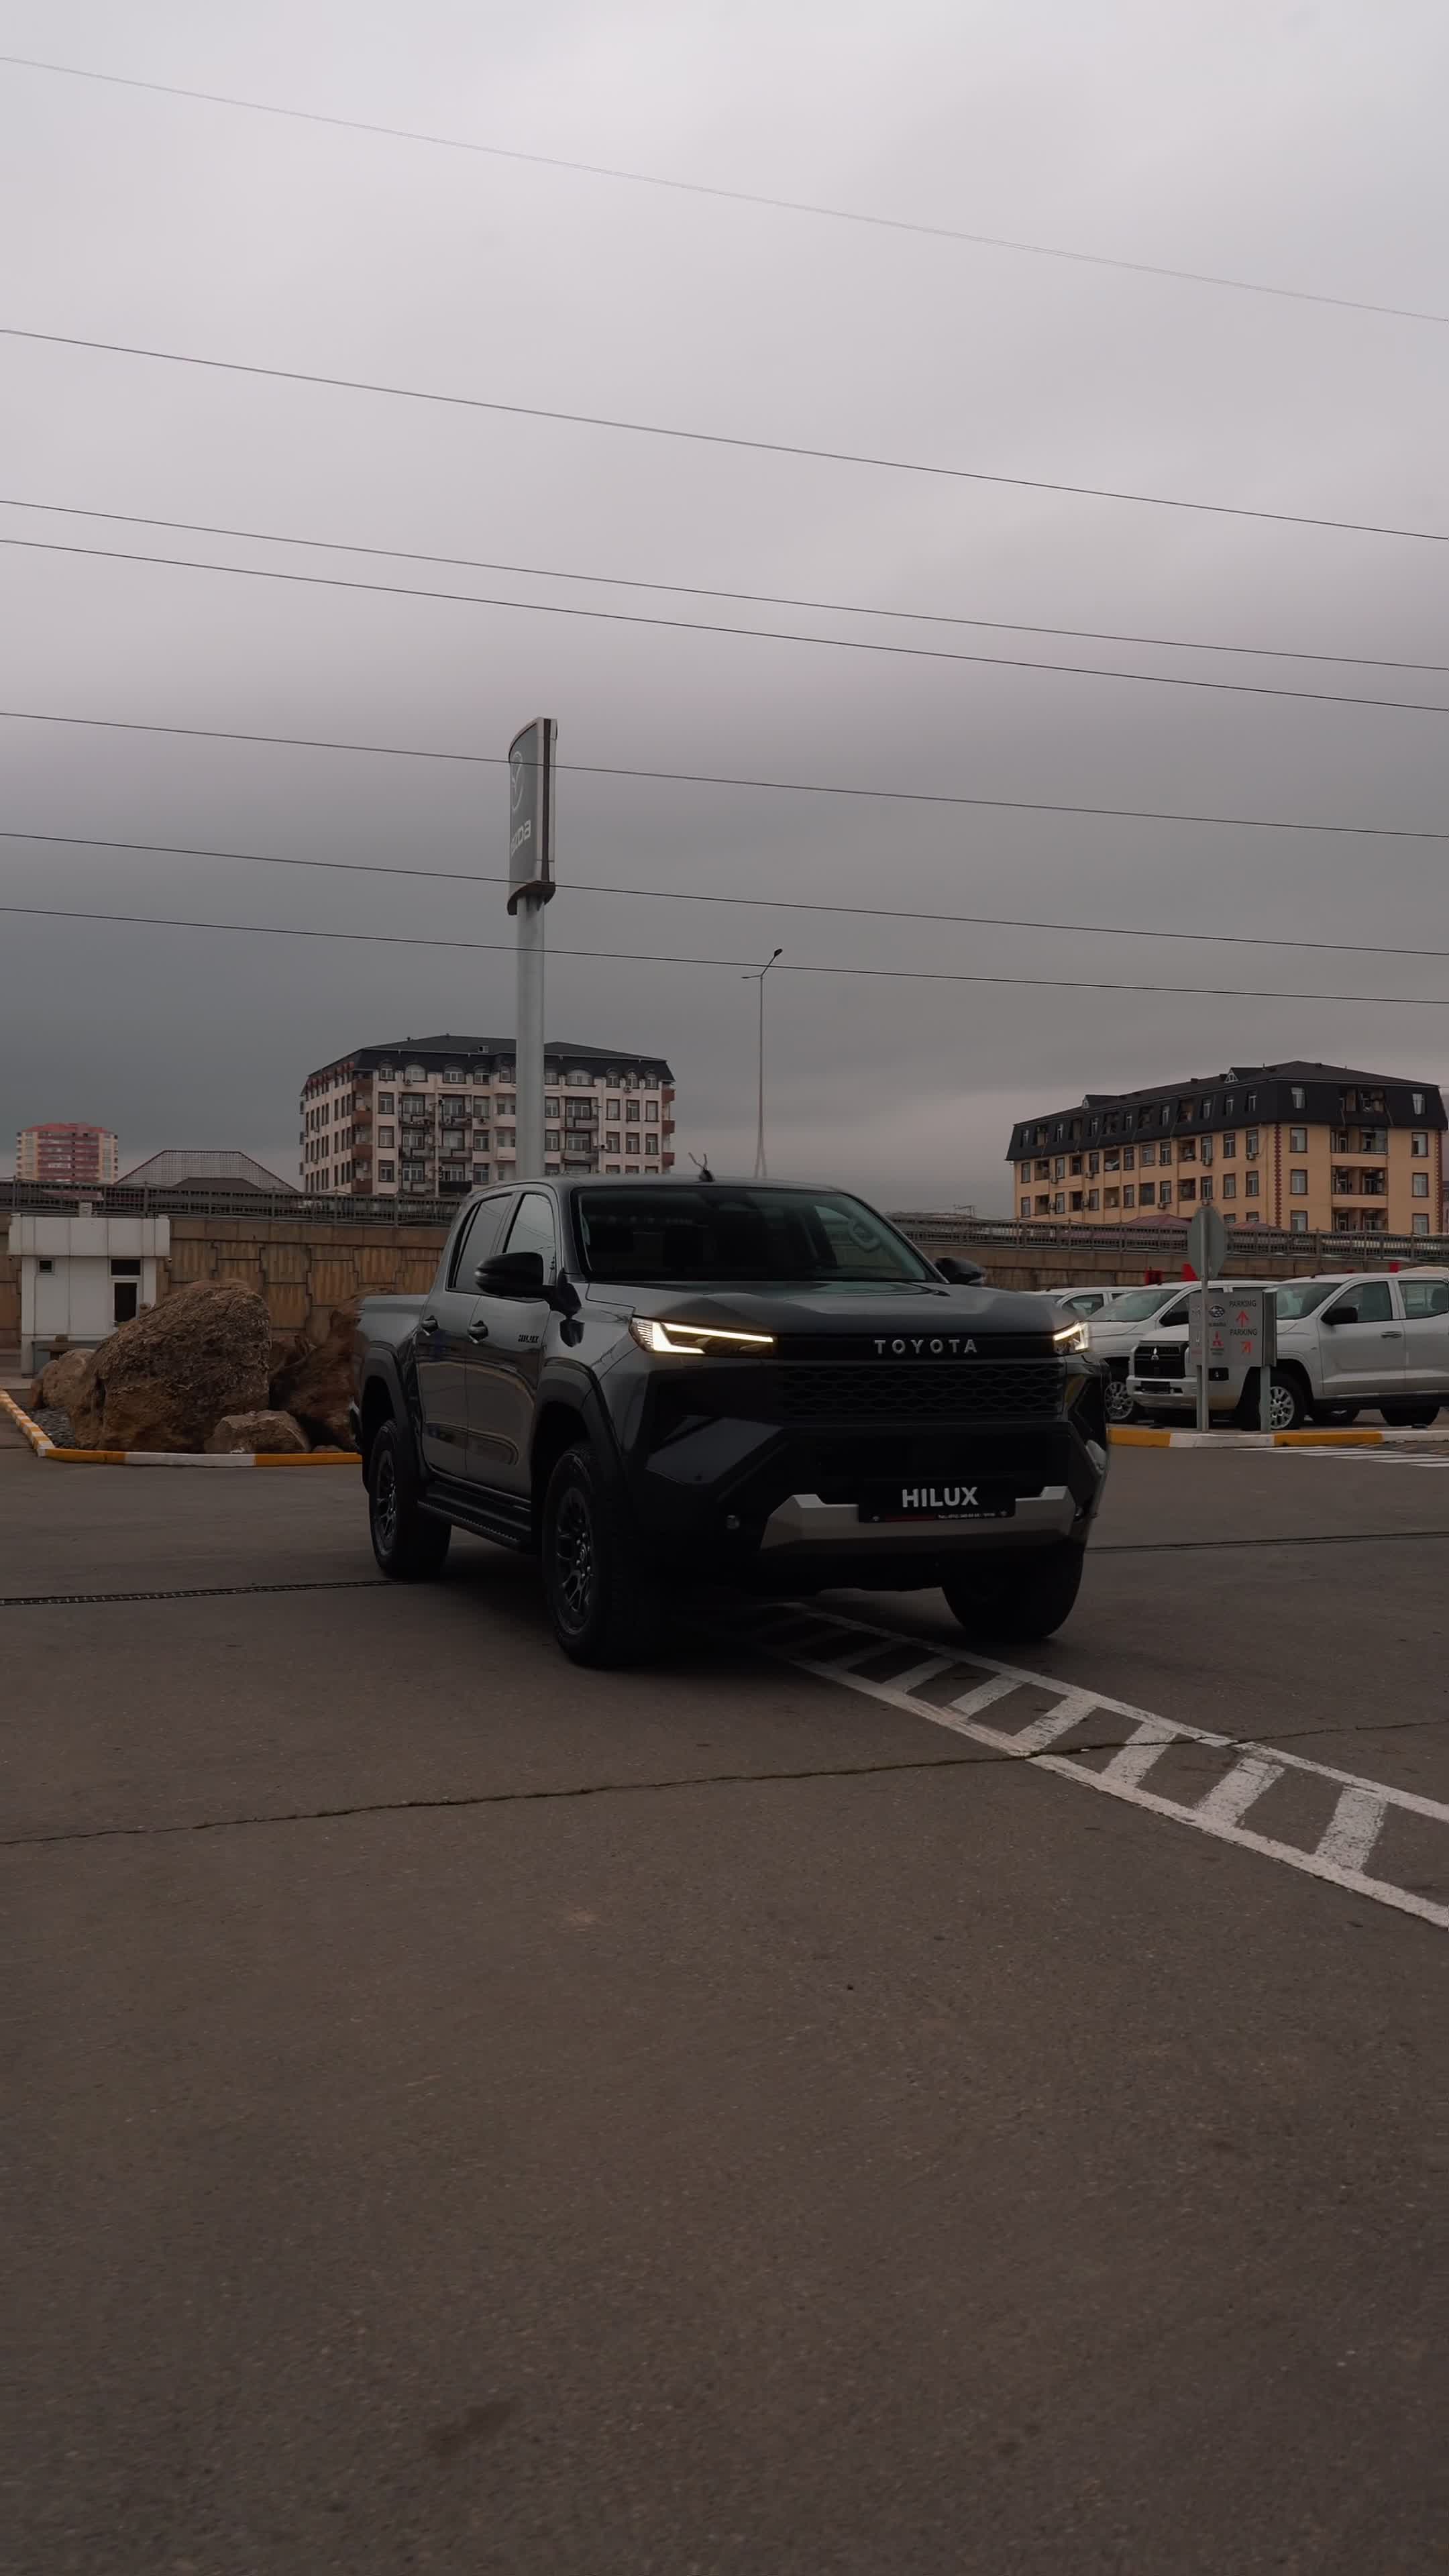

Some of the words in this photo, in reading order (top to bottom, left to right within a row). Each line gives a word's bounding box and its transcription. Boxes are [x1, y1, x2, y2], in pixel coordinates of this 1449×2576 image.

[1229, 1299, 1256, 1307] PARKING
[874, 1339, 977, 1354] TOYOTA
[902, 1487, 979, 1508] HILUX
